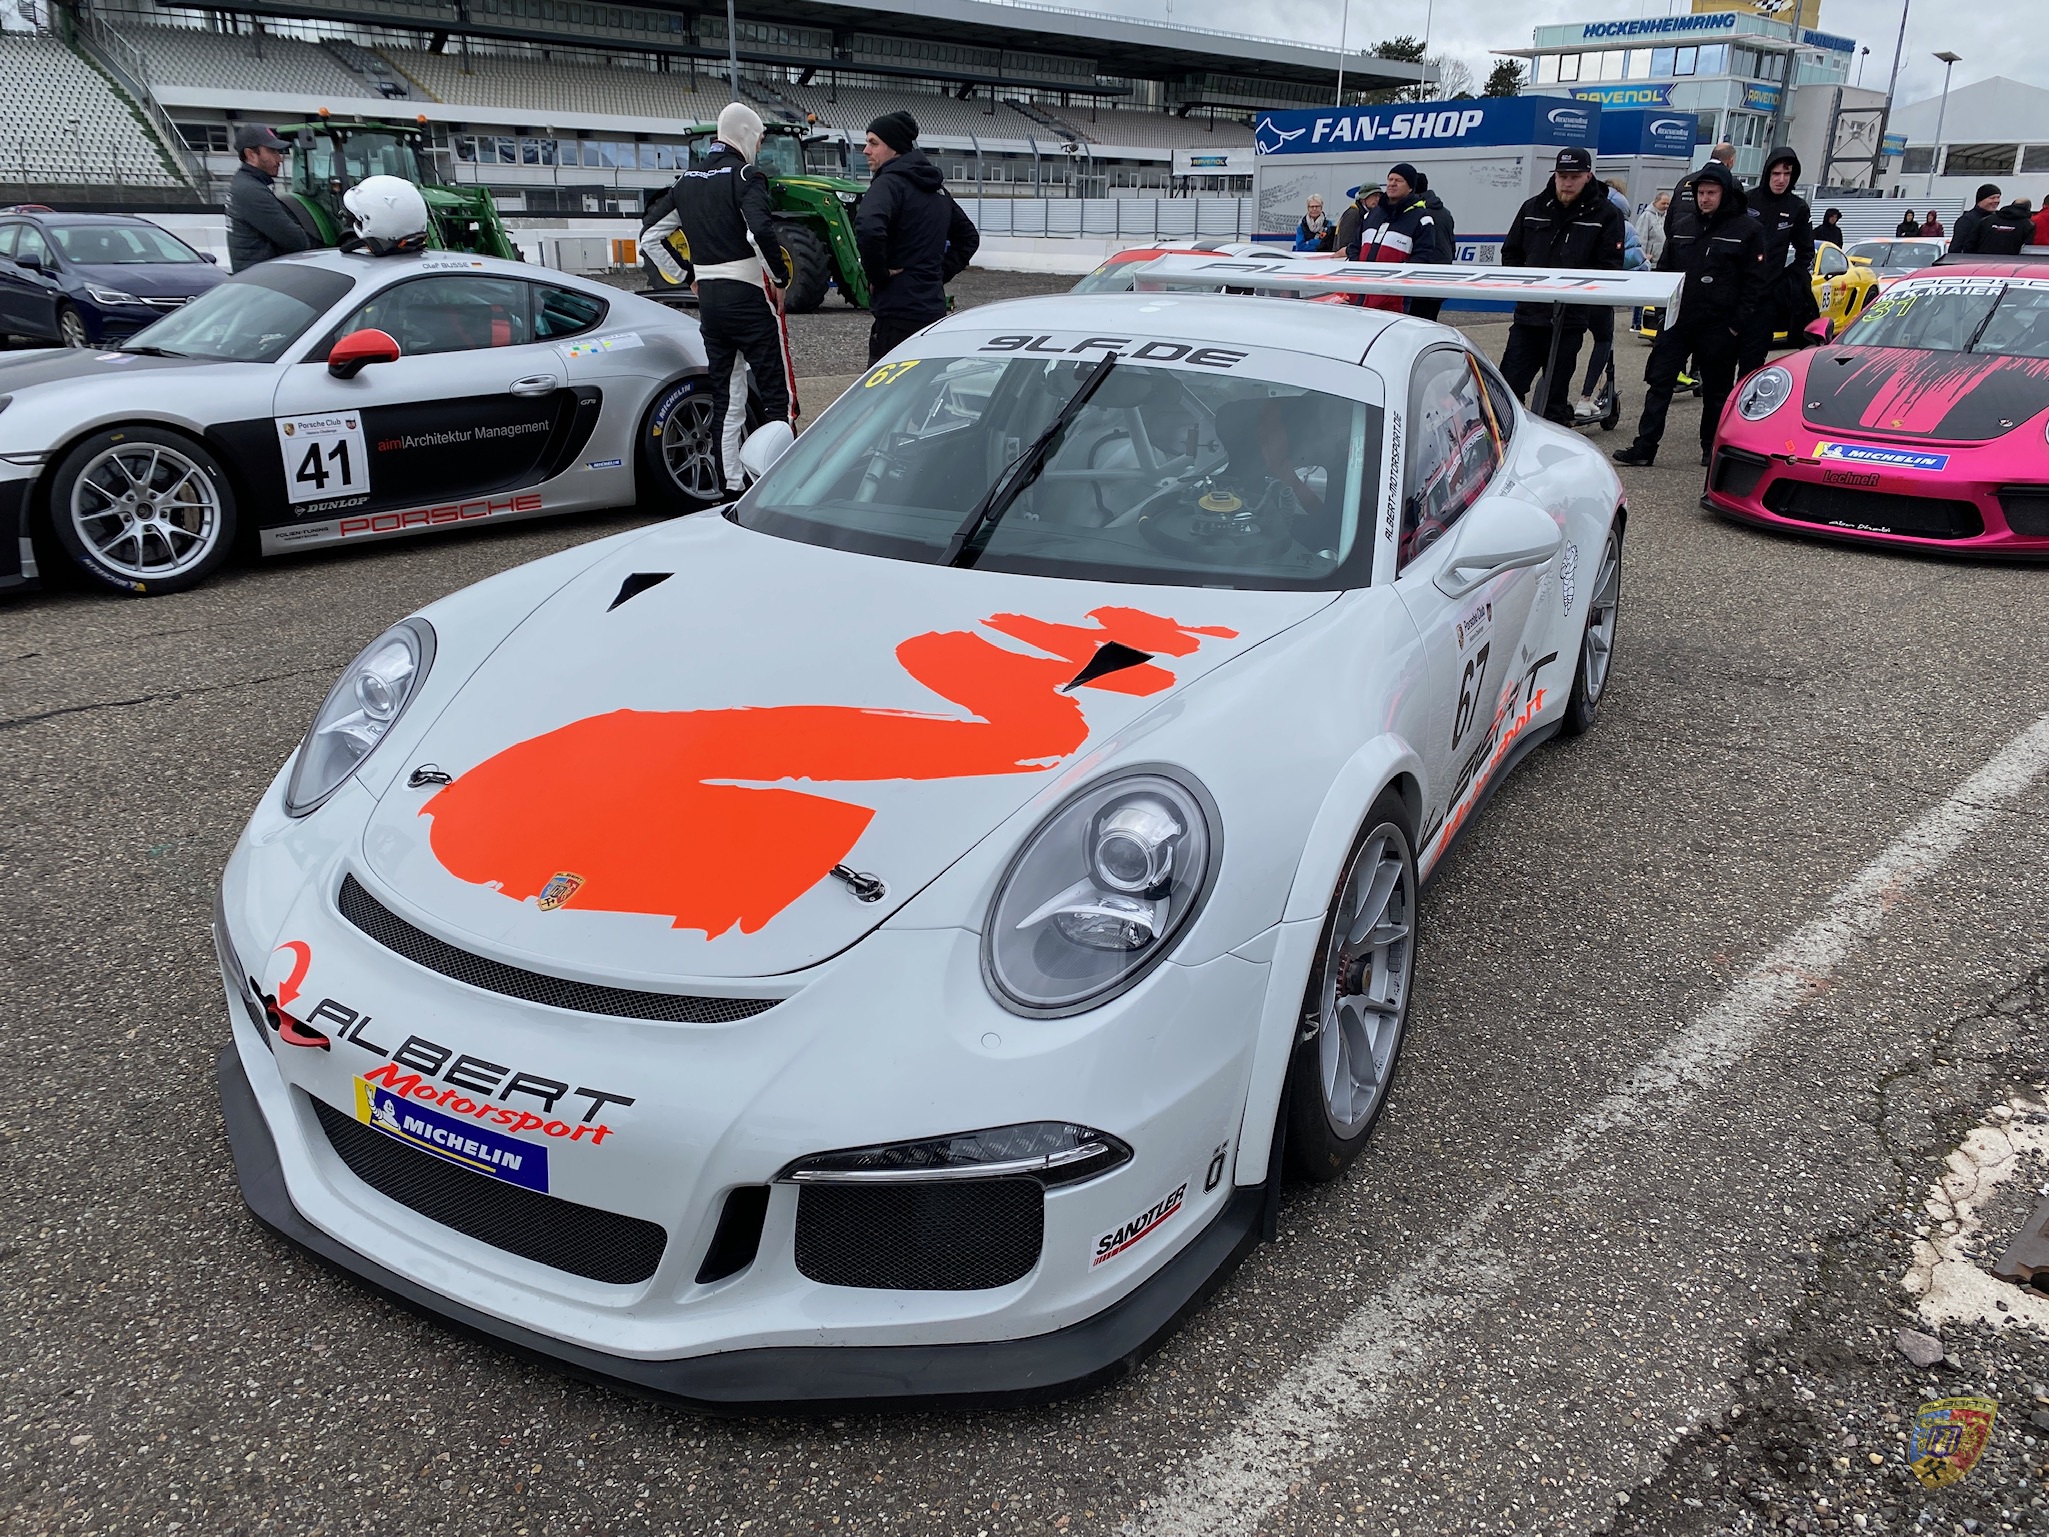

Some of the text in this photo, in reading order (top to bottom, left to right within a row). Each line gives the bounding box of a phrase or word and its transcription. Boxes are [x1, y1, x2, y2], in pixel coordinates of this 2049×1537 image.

[1583, 13, 1737, 38] HOCKENHEIMRING
[1312, 110, 1484, 143] FAN-SHOP
[1191, 262, 1630, 287] ALBERT
[1861, 296, 1919, 322] 31
[864, 359, 921, 389] 67
[659, 383, 691, 420] MICHELIN
[297, 418, 342, 429] Porsche Club
[474, 420, 549, 440] Management
[295, 439, 352, 490] 41
[1847, 449, 1937, 466] MICHELIN
[306, 497, 369, 513] DUNLOP
[340, 494, 542, 537] PORSCHE
[1451, 640, 1490, 751] 67
[306, 998, 636, 1123] ALBERT
[363, 1062, 614, 1145] Motorsport
[402, 1115, 523, 1170] MICHELIN
[1096, 1182, 1188, 1256] SANDTLER
